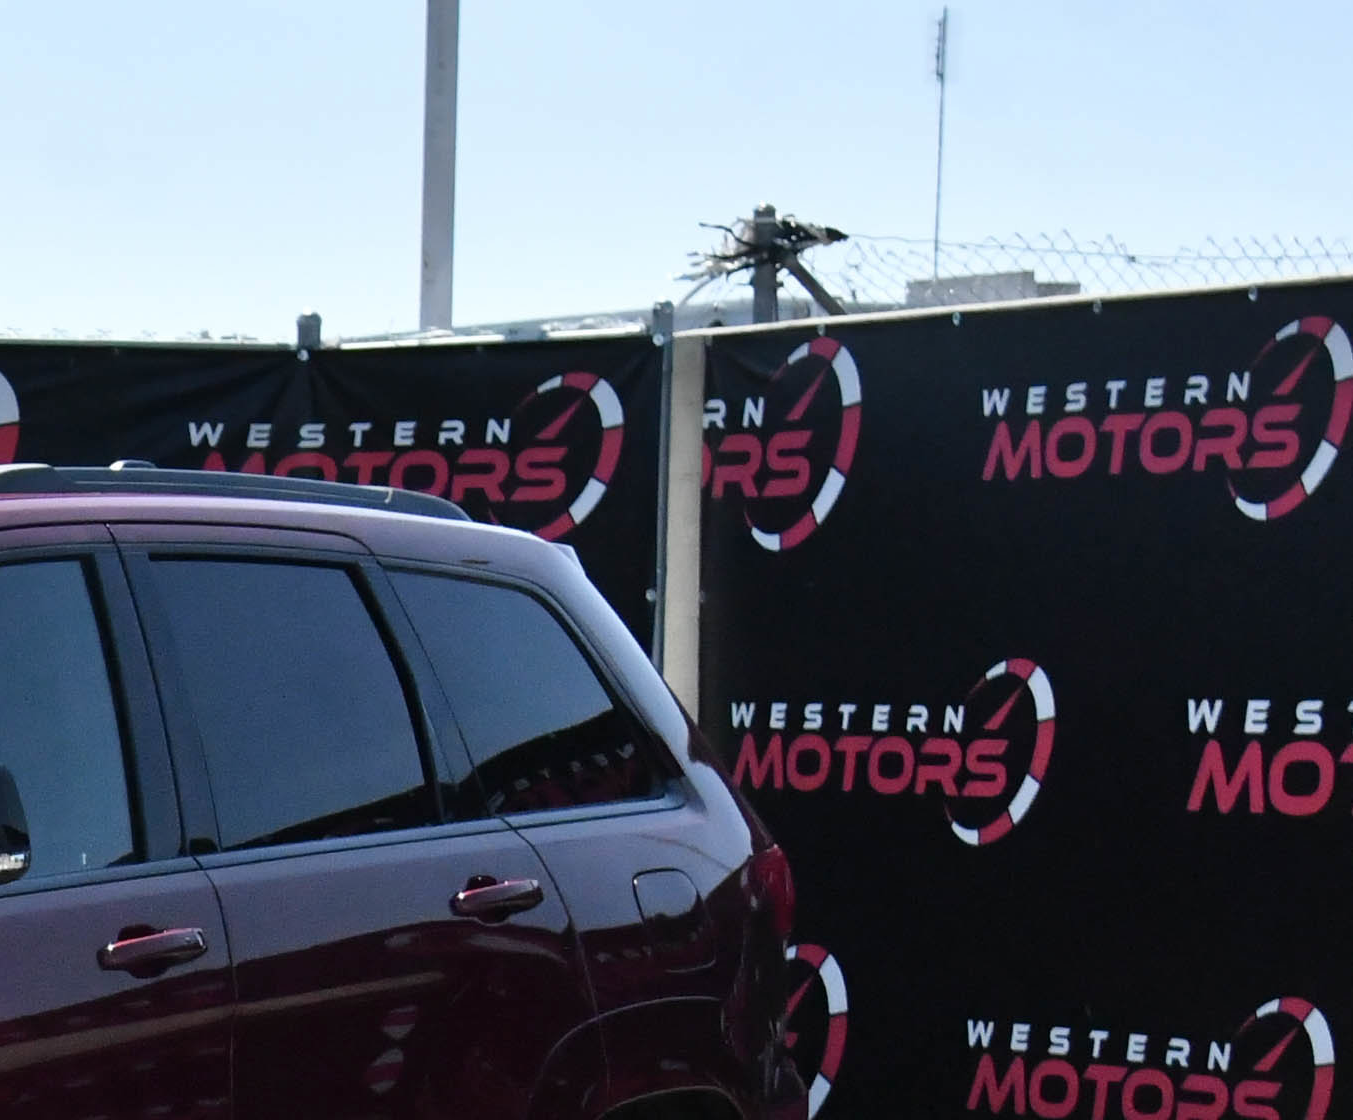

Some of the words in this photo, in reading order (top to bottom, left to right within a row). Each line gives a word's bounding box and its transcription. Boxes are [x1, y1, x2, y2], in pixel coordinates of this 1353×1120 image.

[982, 371, 1251, 417] WESTERN
[188, 418, 512, 448] WESTERN
[982, 404, 1302, 481] MOTORS
[730, 702, 965, 734] WESTERN
[1187, 698, 1353, 735] WES
[732, 731, 1009, 798] MOTORS
[1186, 739, 1353, 817] MO
[967, 1019, 1232, 1073] WESTERN
